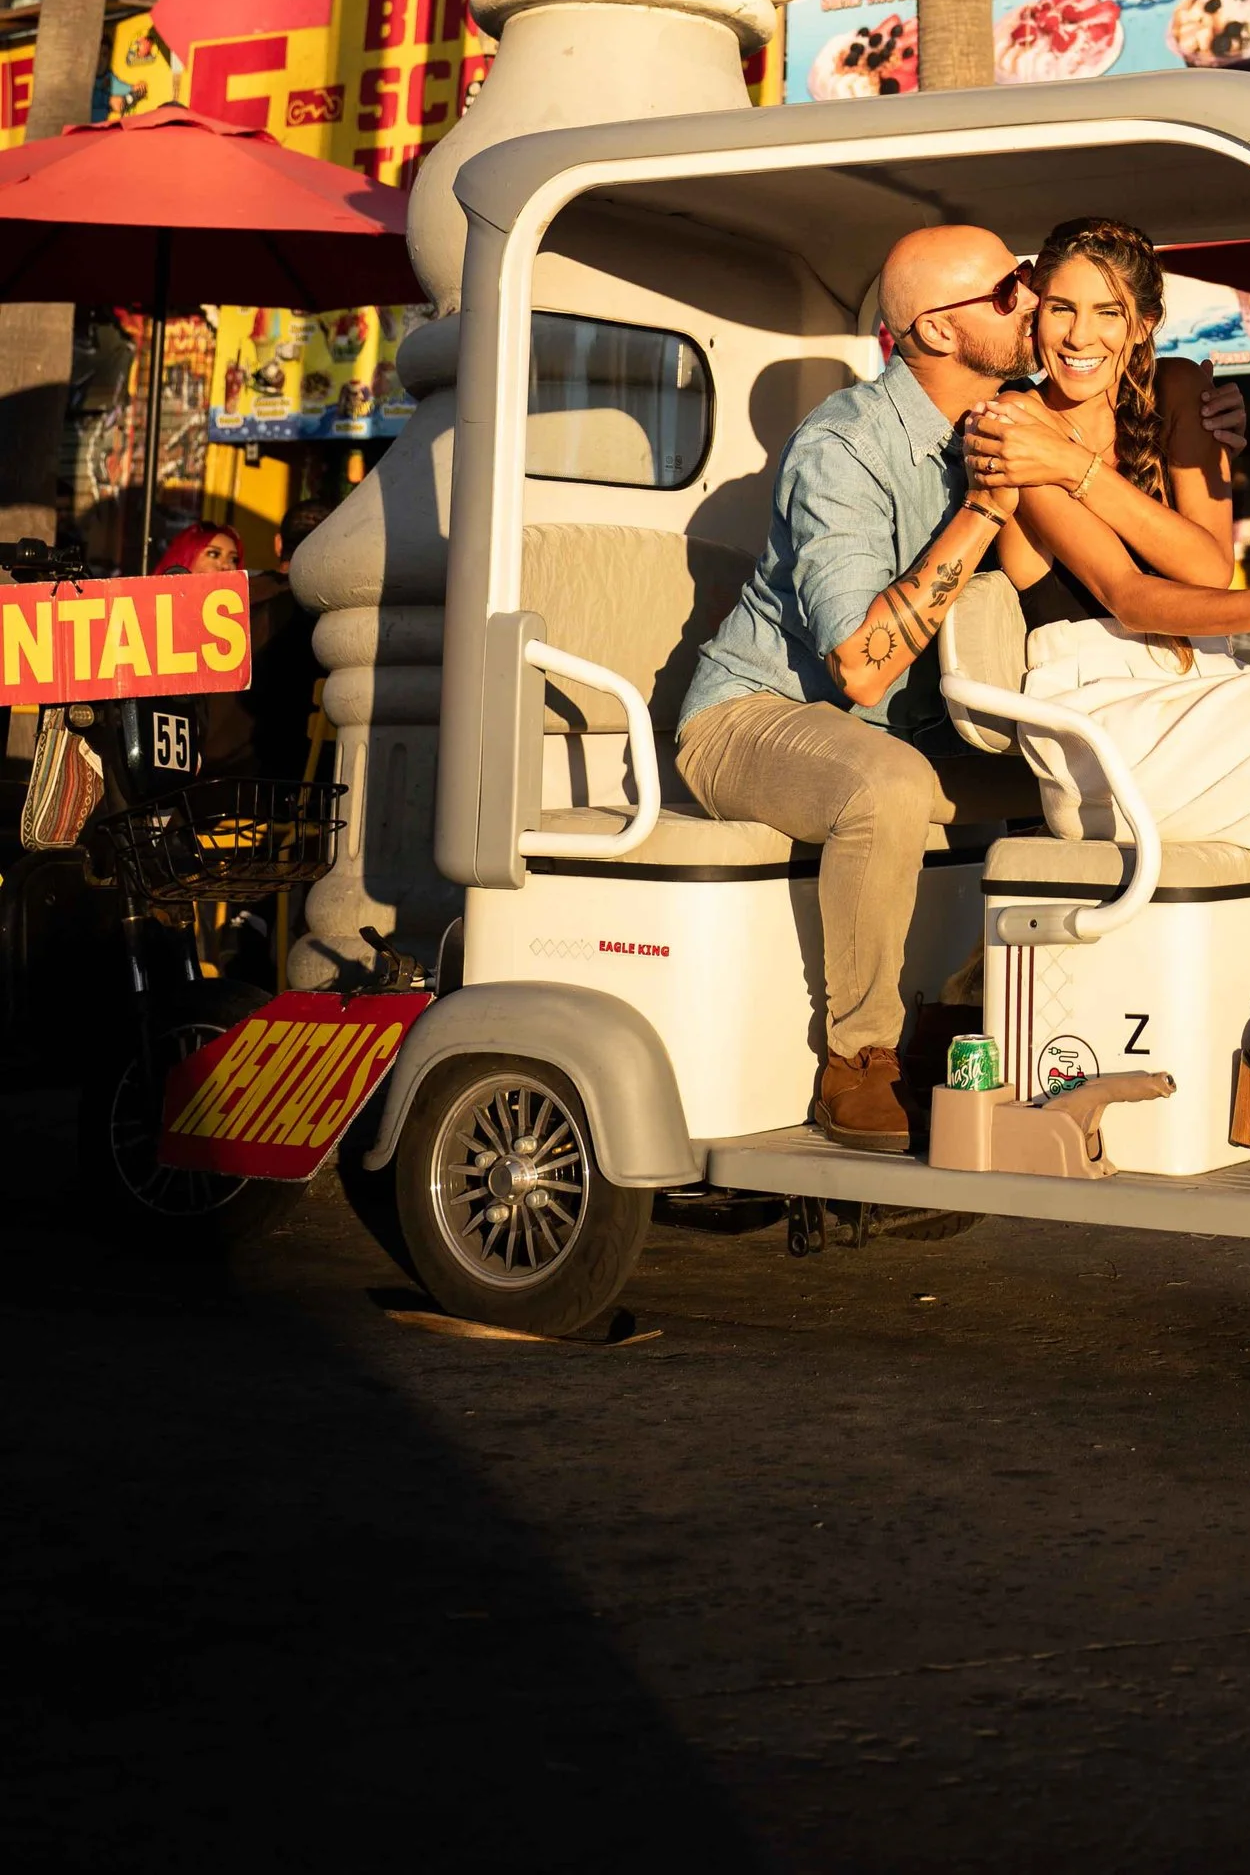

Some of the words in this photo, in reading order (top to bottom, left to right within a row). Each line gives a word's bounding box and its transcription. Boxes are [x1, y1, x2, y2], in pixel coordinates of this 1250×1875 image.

[157, 715, 190, 767] 55
[599, 940, 635, 954] EAGLE
[638, 943, 670, 957] KING
[1124, 1013, 1151, 1055] Z
[169, 1019, 403, 1148] RENTALS
